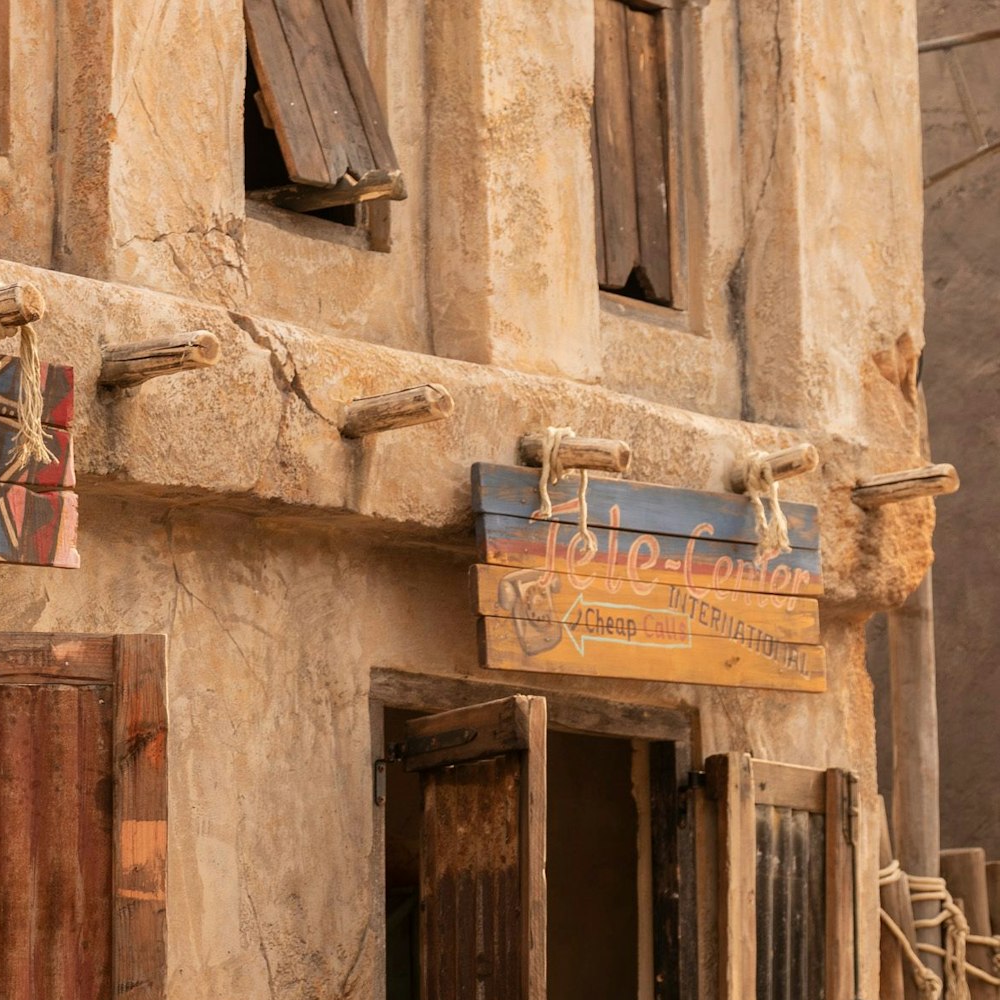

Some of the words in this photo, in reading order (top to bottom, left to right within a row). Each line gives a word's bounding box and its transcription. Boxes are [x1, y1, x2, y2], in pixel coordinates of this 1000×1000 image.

[529, 497, 812, 612] Tele-Center
[584, 606, 638, 642] Cheap
[642, 611, 689, 641] Calls
[667, 584, 813, 681] INTERNATIONAL
